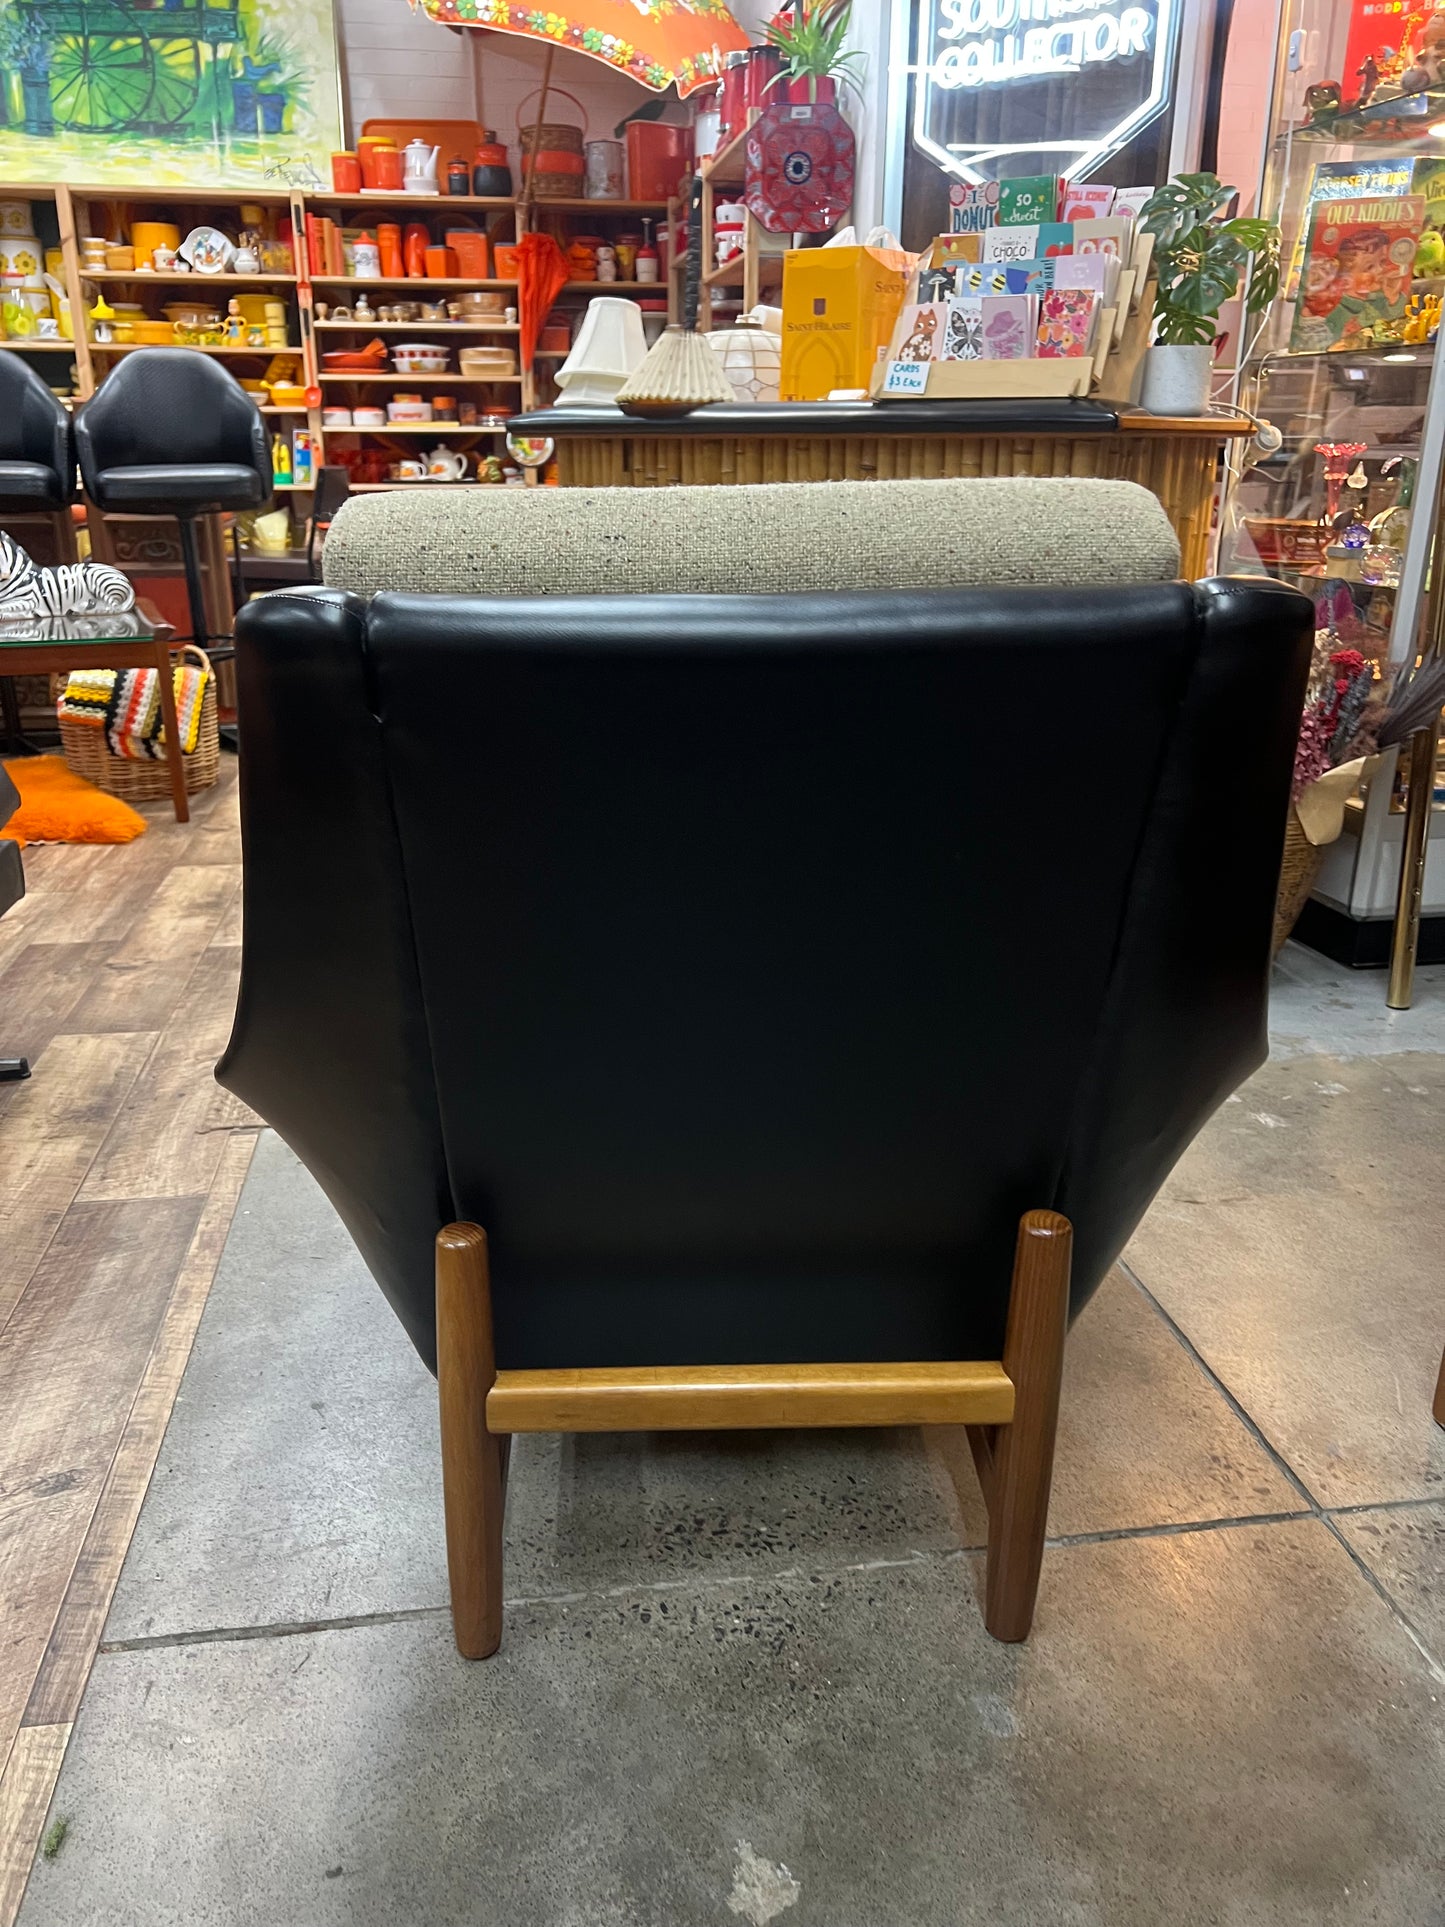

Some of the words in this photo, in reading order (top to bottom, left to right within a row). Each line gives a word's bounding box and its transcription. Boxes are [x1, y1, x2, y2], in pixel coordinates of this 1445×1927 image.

[934, 7, 1150, 89] COLLECTOR
[971, 190, 977, 203] I
[953, 205, 996, 233] DONUT
[1326, 204, 1356, 225] OUR
[993, 245, 1027, 258] CHOCO
[893, 363, 920, 374] CARDS
[889, 374, 901, 389] $3
